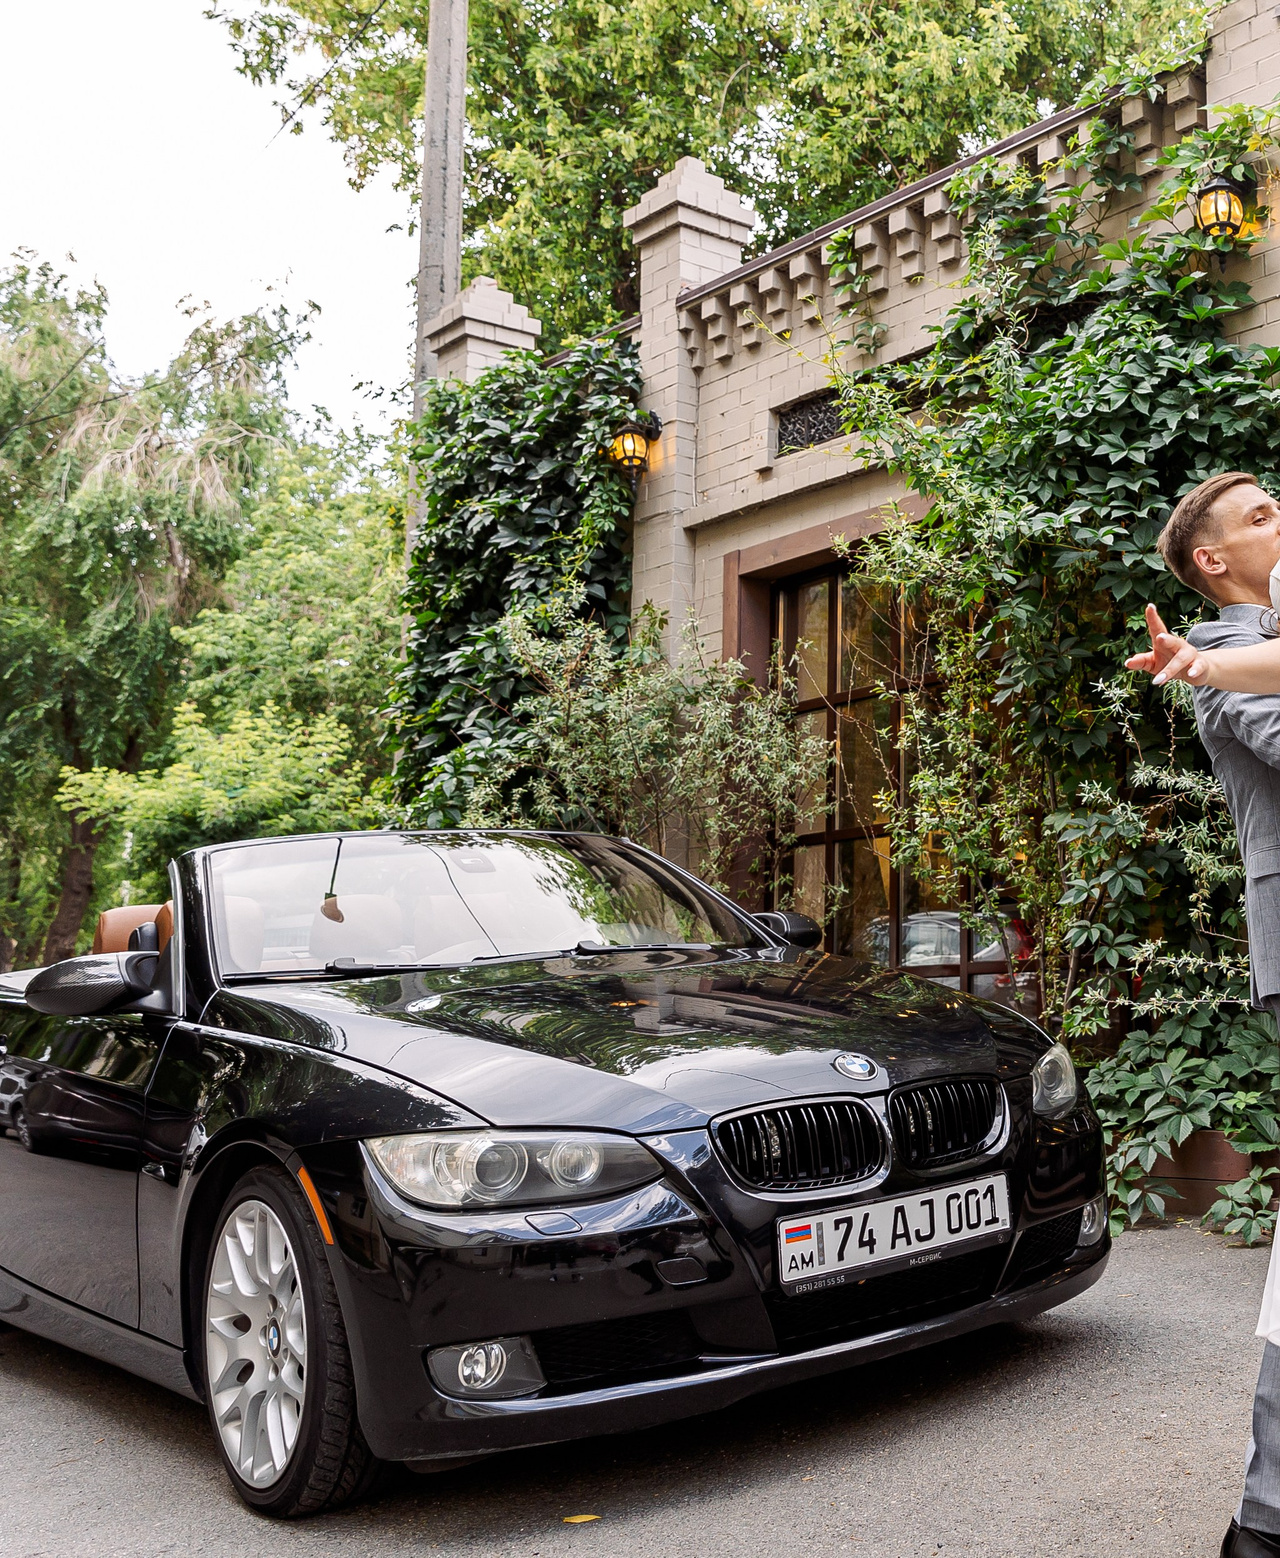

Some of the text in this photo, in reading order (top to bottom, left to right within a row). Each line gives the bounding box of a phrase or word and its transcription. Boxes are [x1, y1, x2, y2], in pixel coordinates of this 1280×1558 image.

[834, 1184, 1000, 1262] 74 AJ 001
[788, 1250, 814, 1273] AM
[795, 1275, 845, 1294] (351) 281 55 55
